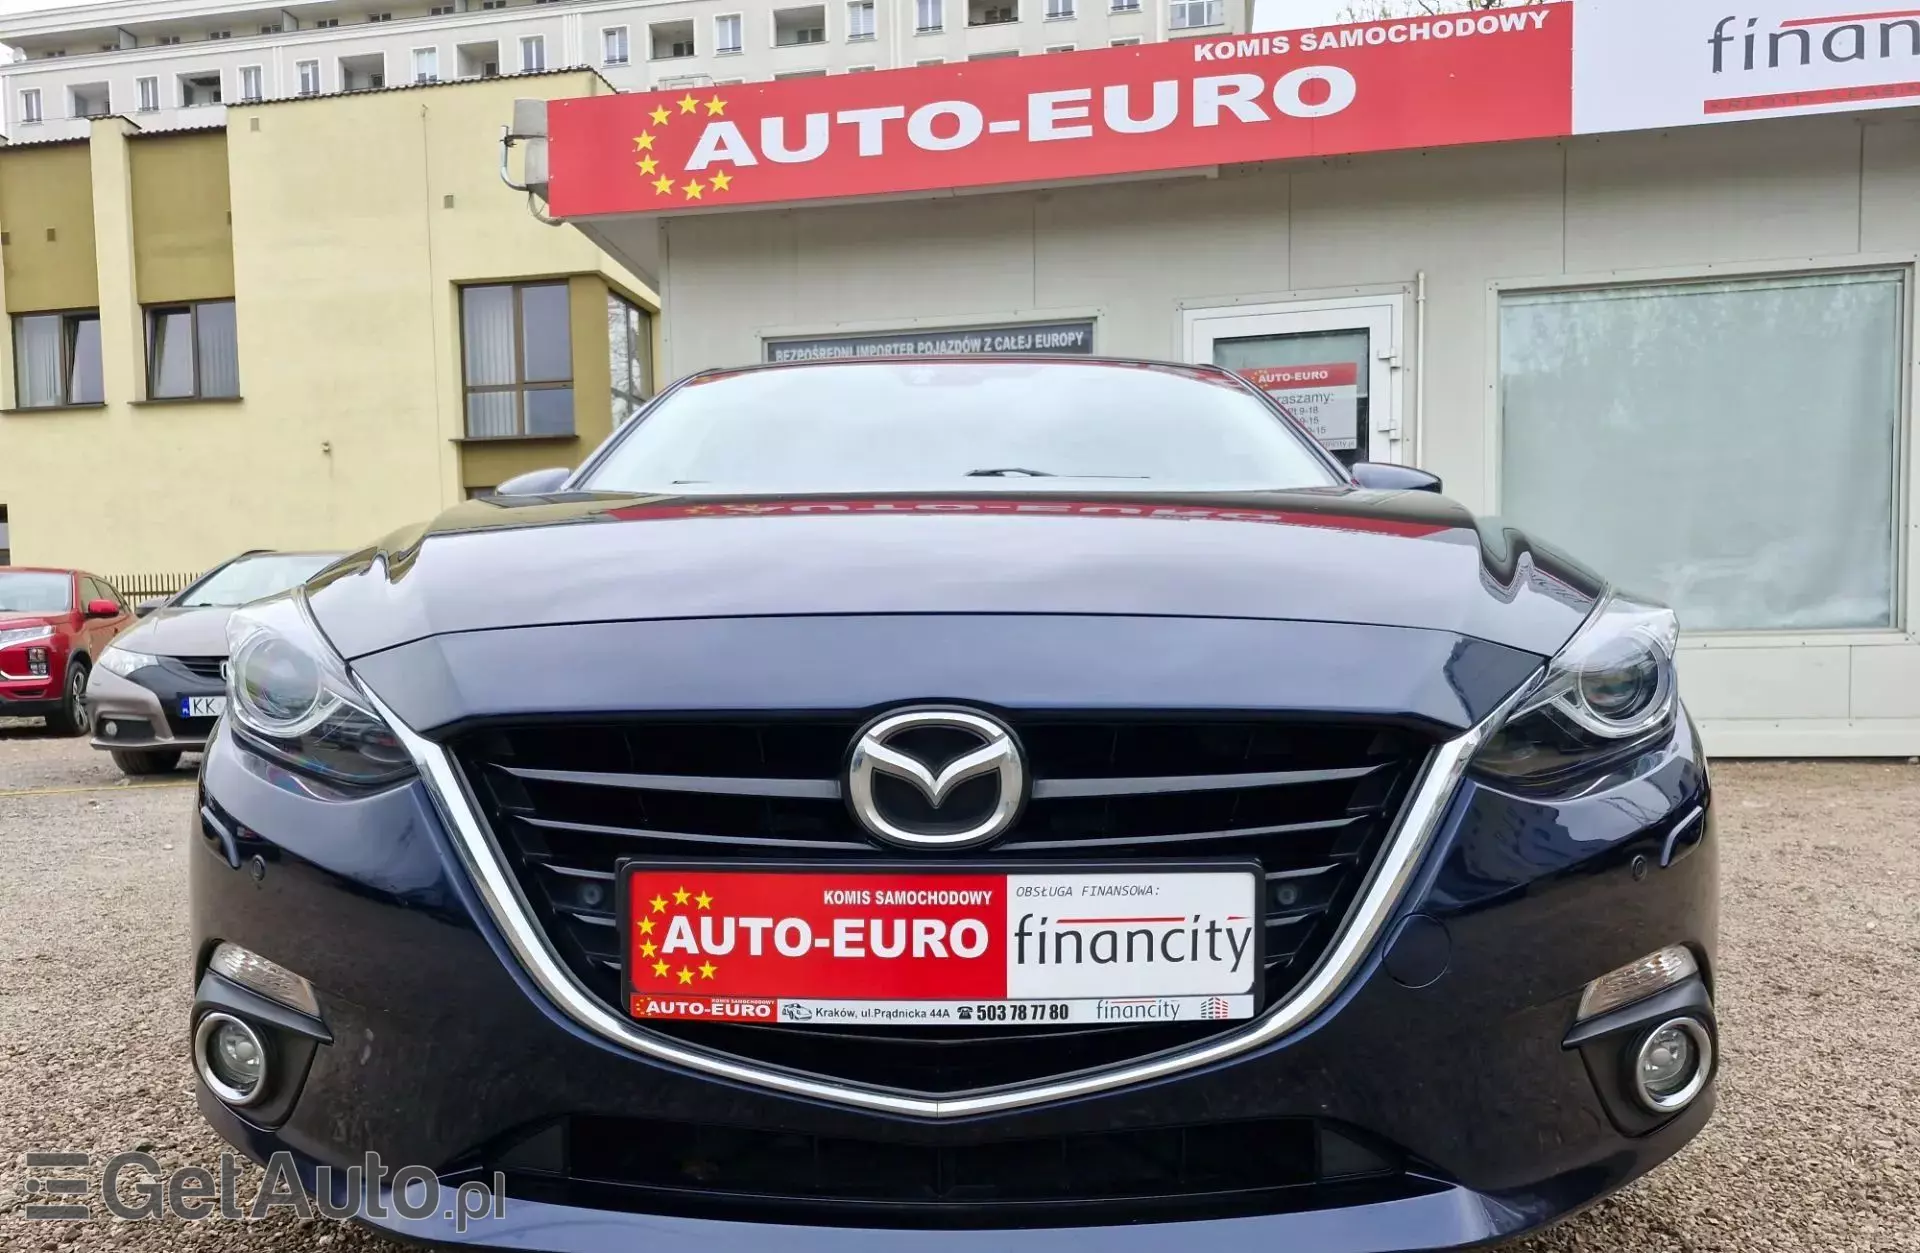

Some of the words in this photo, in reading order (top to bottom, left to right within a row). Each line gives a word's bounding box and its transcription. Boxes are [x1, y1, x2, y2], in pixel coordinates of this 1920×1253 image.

[1194, 35, 1290, 62] KOMIS
[1299, 9, 1550, 52] SAMOCHODOWY
[684, 65, 1357, 172] AUTO-EURO
[775, 344, 854, 362] BEZPOŚREDNI
[857, 342, 914, 357] IMPORTER
[917, 337, 981, 355] POJAZDÓW
[984, 337, 993, 351] Z
[994, 333, 1032, 351] CAŁEJ
[1035, 331, 1084, 348] EUROPY
[1258, 370, 1329, 383] AUTO-EURO
[823, 890, 871, 905] KOMIS
[875, 890, 992, 905] SAMOCHODOWY
[1016, 886, 1073, 897] OBSŁUGA
[1081, 885, 1161, 897] FINANSOWA:
[661, 915, 990, 959] AUTO-EURO
[1014, 913, 1253, 973] financity
[645, 1001, 771, 1018] AUTO-EURO
[816, 1007, 858, 1020] Kraków,
[930, 1008, 950, 1018] 44A
[977, 1004, 1007, 1021] 503
[1010, 1004, 1028, 1020] 78
[1031, 1004, 1046, 1020] 77
[1049, 1004, 1069, 1020] 80
[1096, 999, 1181, 1021] financity
